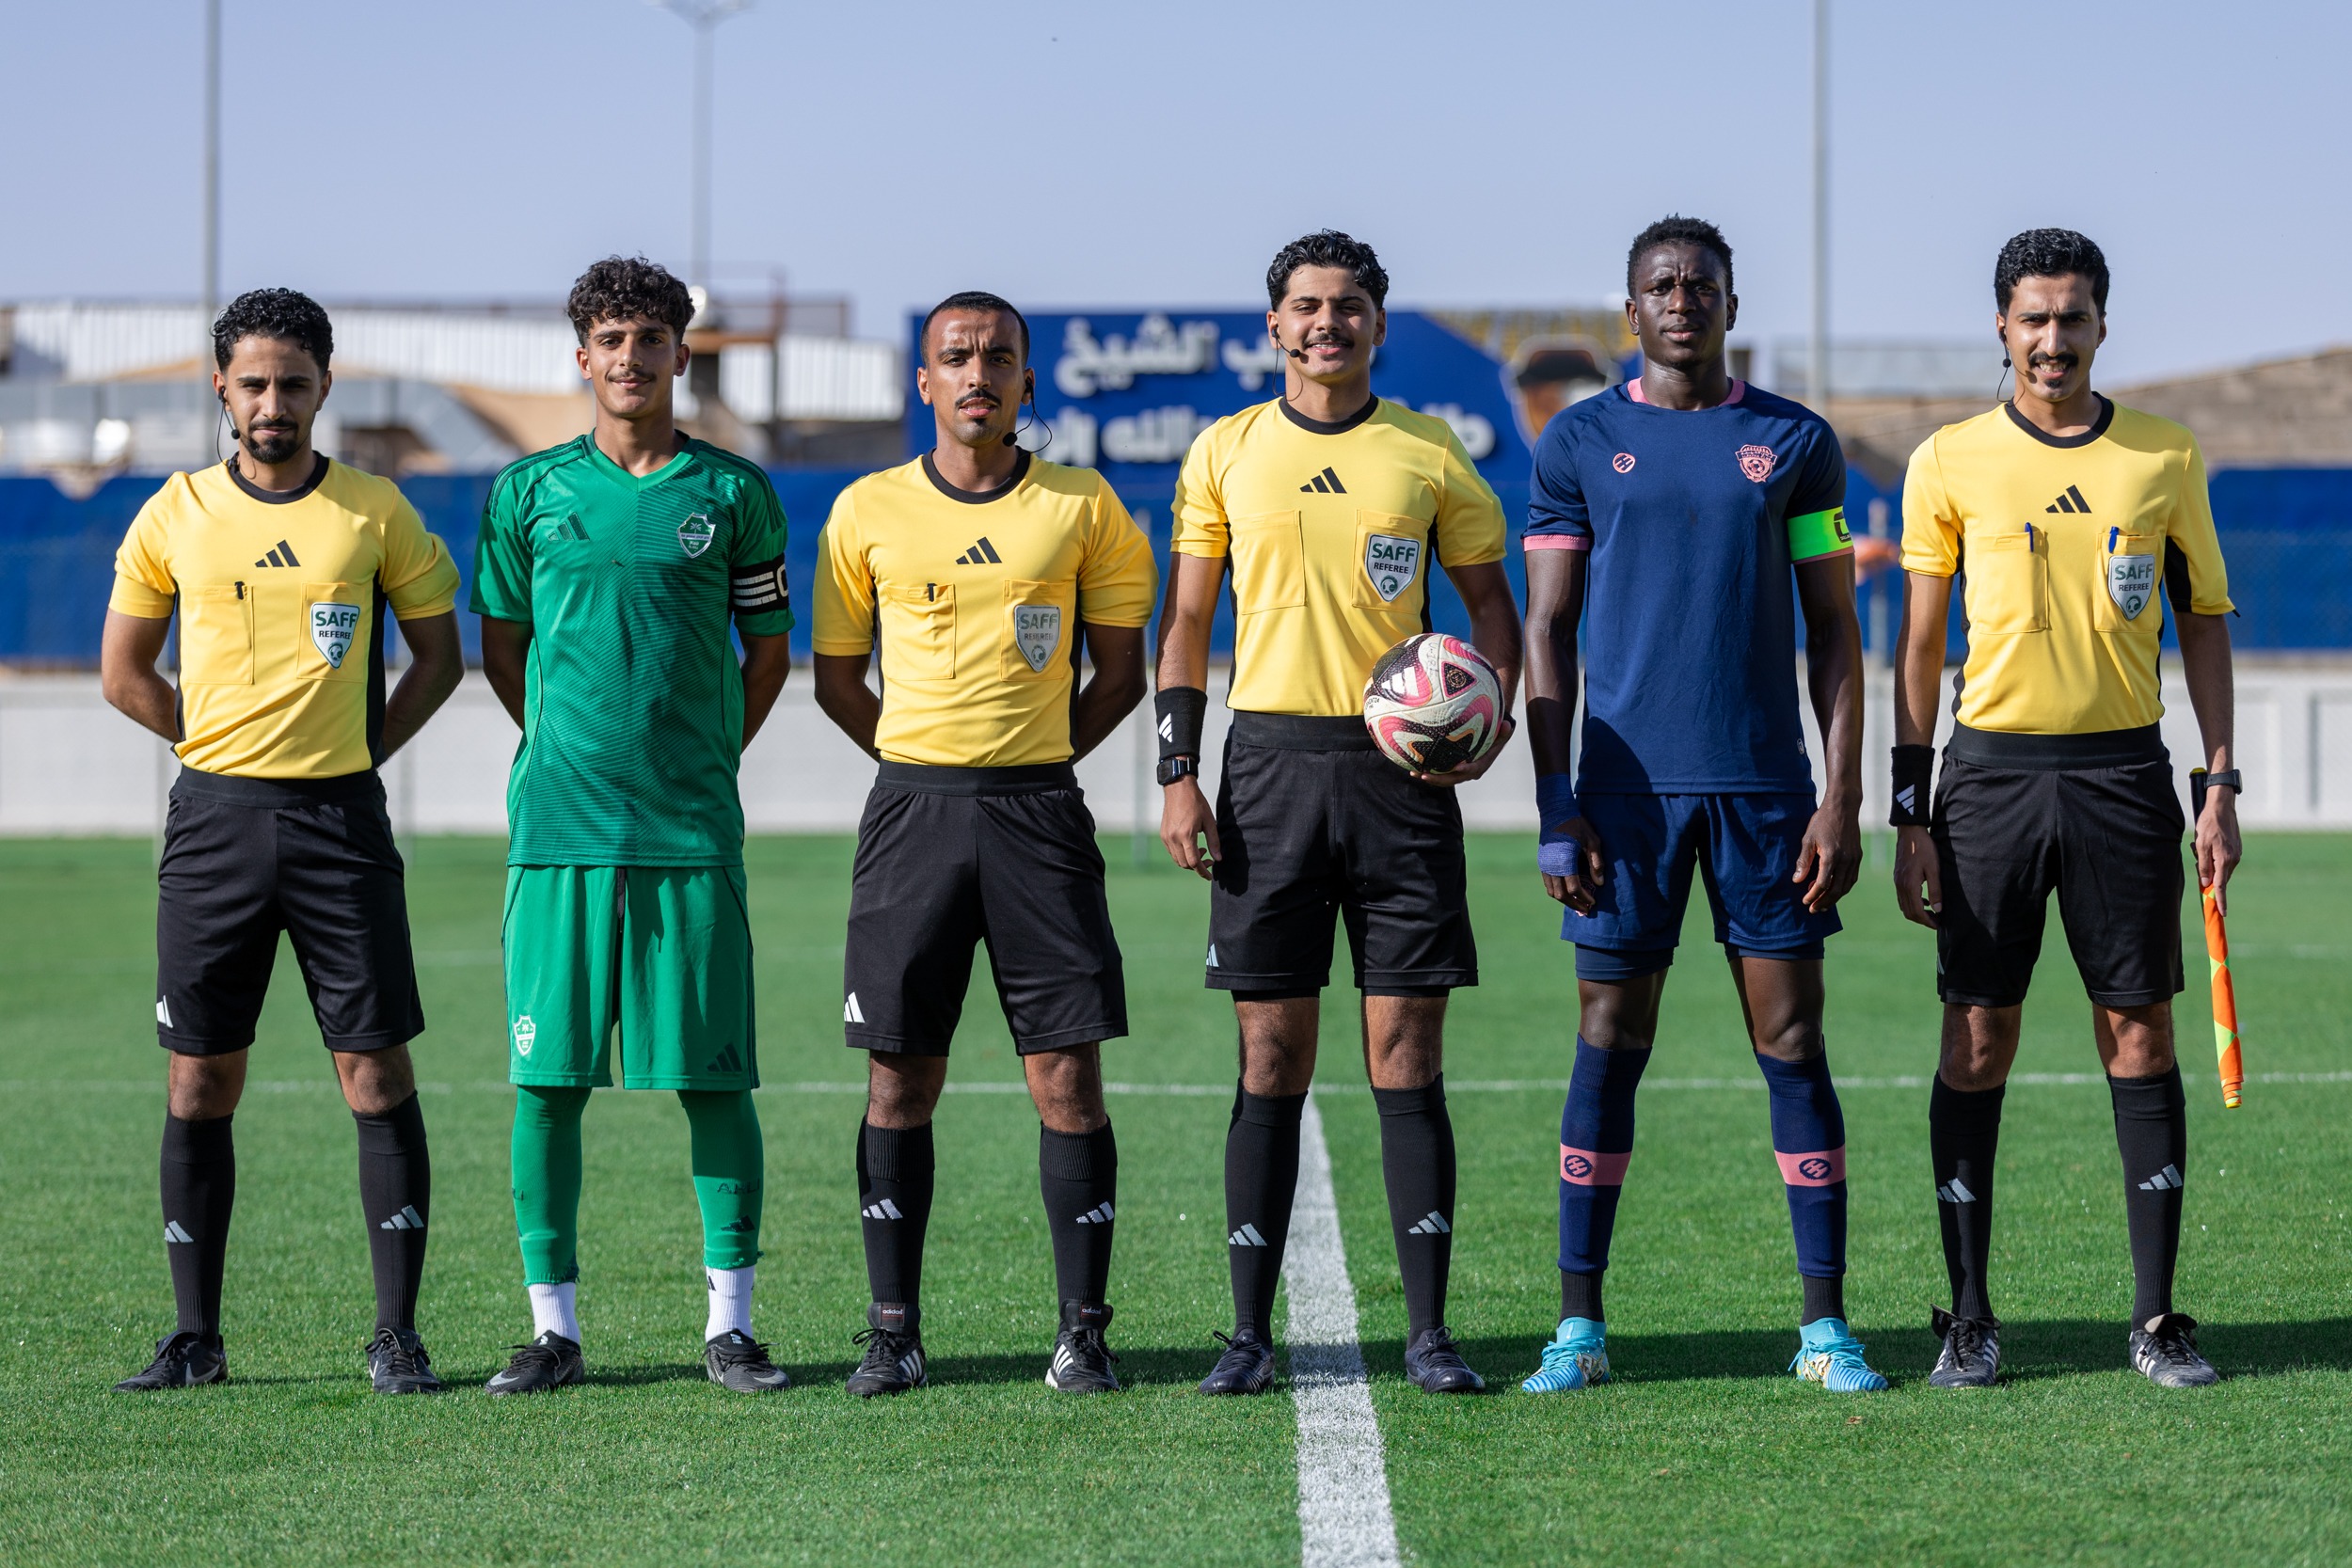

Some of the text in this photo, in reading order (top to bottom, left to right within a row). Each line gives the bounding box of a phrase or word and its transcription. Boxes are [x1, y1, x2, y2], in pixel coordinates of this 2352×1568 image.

[1371, 542, 1416, 562] SAFF
[1374, 562, 1409, 574] REFEREE
[2114, 562, 2153, 580] SAFF
[2118, 582, 2150, 592] REFEREE
[314, 610, 358, 628] SAFF
[1020, 612, 1058, 630] SAFF
[318, 629, 352, 640] REFEREE
[1024, 632, 1053, 641] REFEREE
